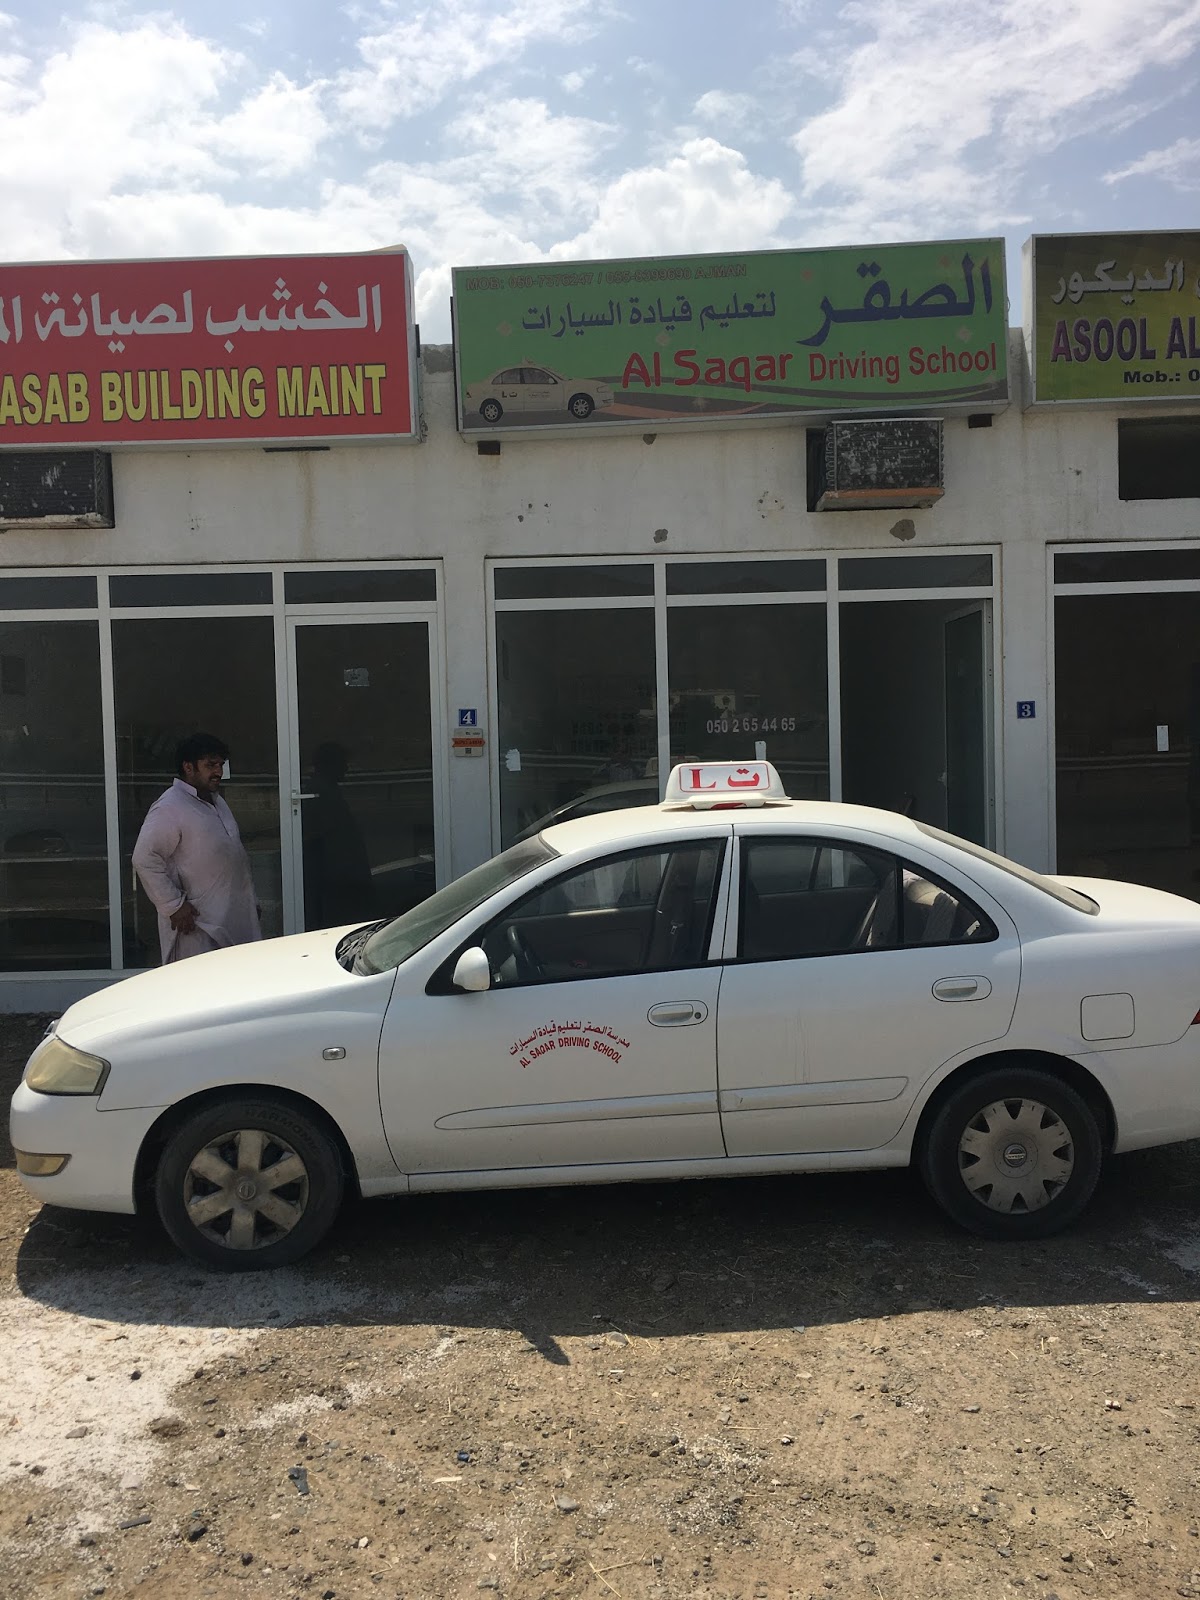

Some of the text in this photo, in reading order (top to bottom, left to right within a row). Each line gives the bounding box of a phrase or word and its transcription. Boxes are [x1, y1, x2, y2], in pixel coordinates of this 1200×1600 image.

[466, 276, 504, 291] MOB:
[695, 263, 747, 279] AJMAN
[1051, 259, 1184, 305] الديكور
[796, 252, 992, 347] الصقر
[34, 289, 194, 353] لصيانة
[205, 277, 382, 353] الخشب
[522, 291, 776, 338] لتعليم قيادة السيارات
[1051, 316, 1156, 363] ASOOL
[622, 342, 997, 393] Al Saqar Driving School
[1124, 370, 1181, 384] Mob.:
[101, 366, 267, 423] BUILDING
[276, 363, 388, 418] MAINT
[462, 710, 473, 725] 4
[1021, 703, 1031, 717] 3
[706, 716, 796, 734] 050 2 65 44 65
[689, 768, 716, 789] L
[727, 768, 760, 788] ت
[538, 1020, 556, 1037] قيادة
[557, 1020, 582, 1035] لتعليم
[582, 1021, 608, 1035] الصقر
[509, 1029, 539, 1056] السيارات
[519, 1036, 622, 1069] AL SAQAR DRIVING SCHOOL
